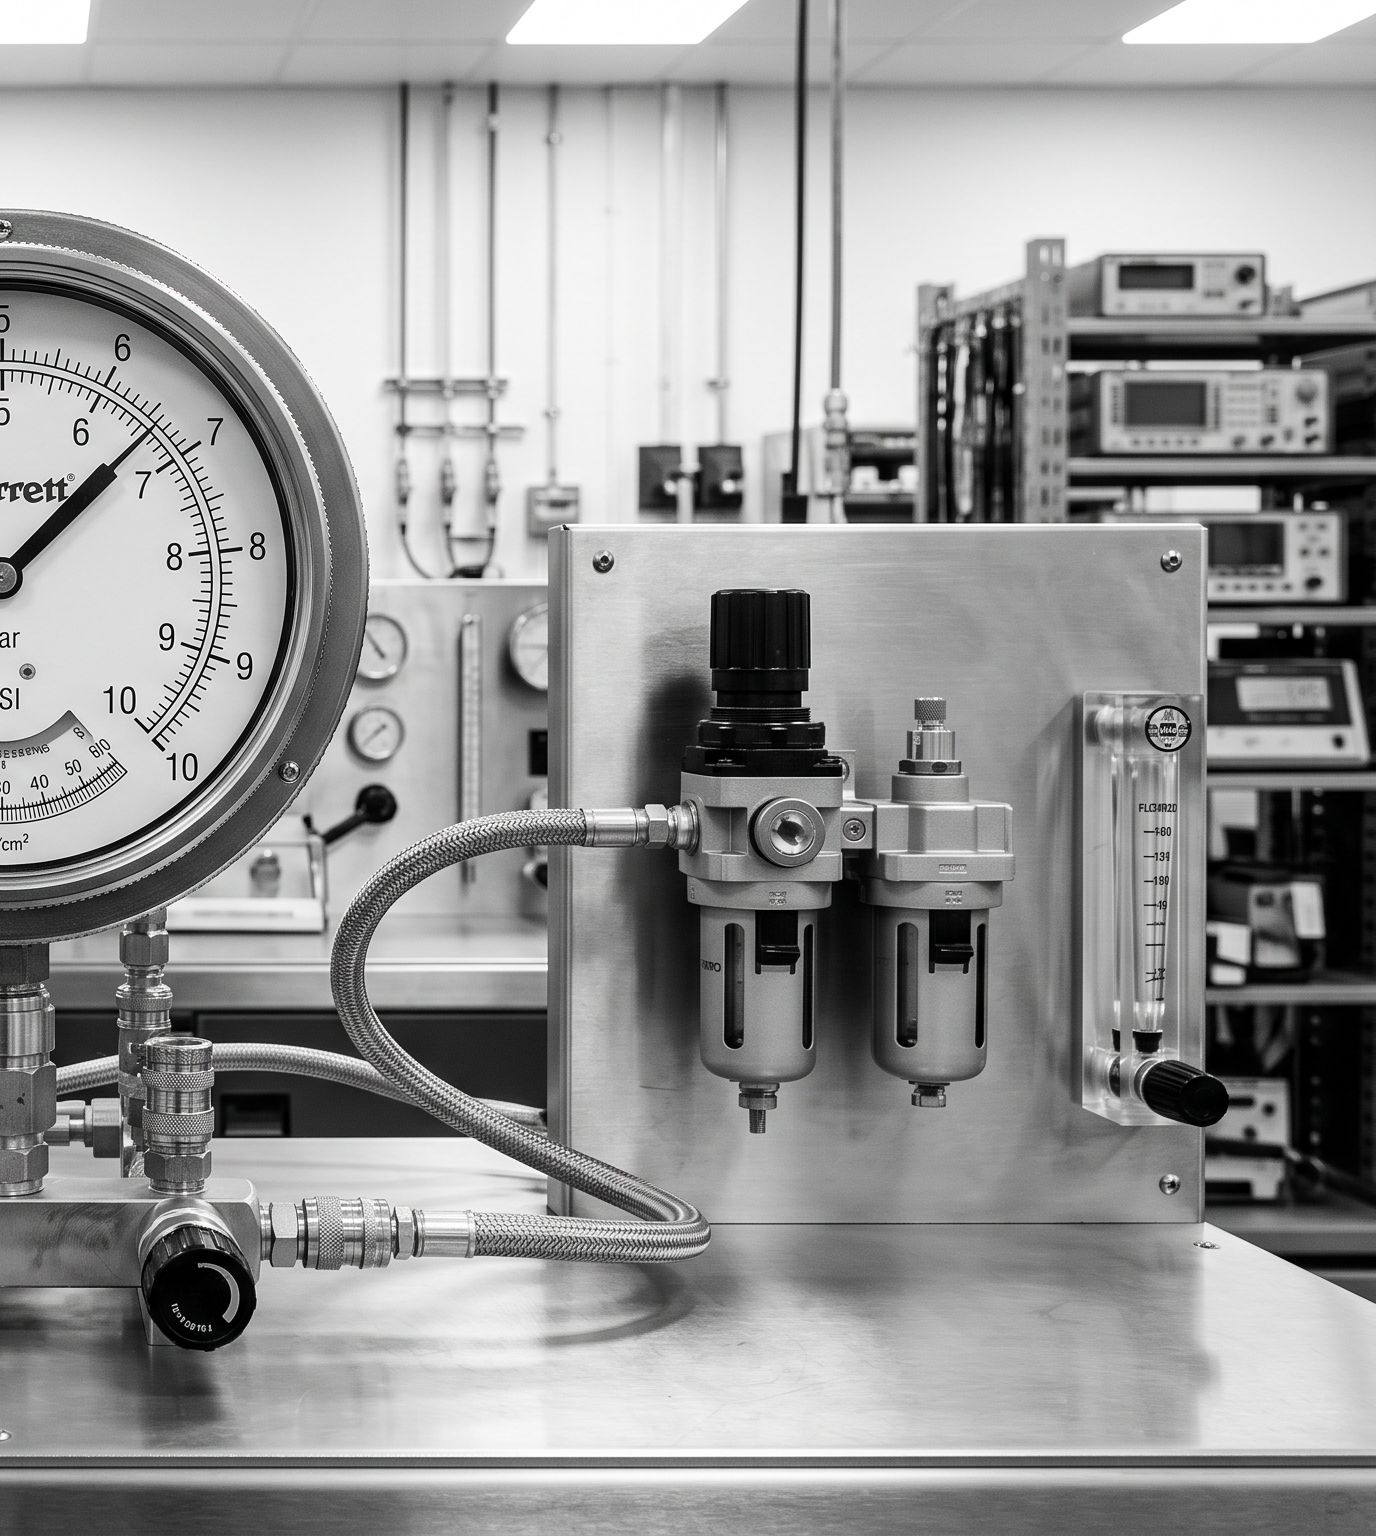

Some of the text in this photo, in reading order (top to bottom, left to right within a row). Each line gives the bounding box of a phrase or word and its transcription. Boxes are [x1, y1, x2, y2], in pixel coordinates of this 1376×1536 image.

[115, 334, 130, 361] 6
[73, 418, 89, 446] 6
[208, 418, 223, 445] 7
[136, 471, 151, 498] 7
[167, 543, 182, 570] 8
[250, 532, 265, 560] 8
[159, 623, 174, 651] 9
[237, 652, 252, 680] 9
[104, 686, 136, 714] 10
[65, 759, 81, 775] 50
[166, 753, 198, 781] 10
[31, 775, 48, 790] 40
